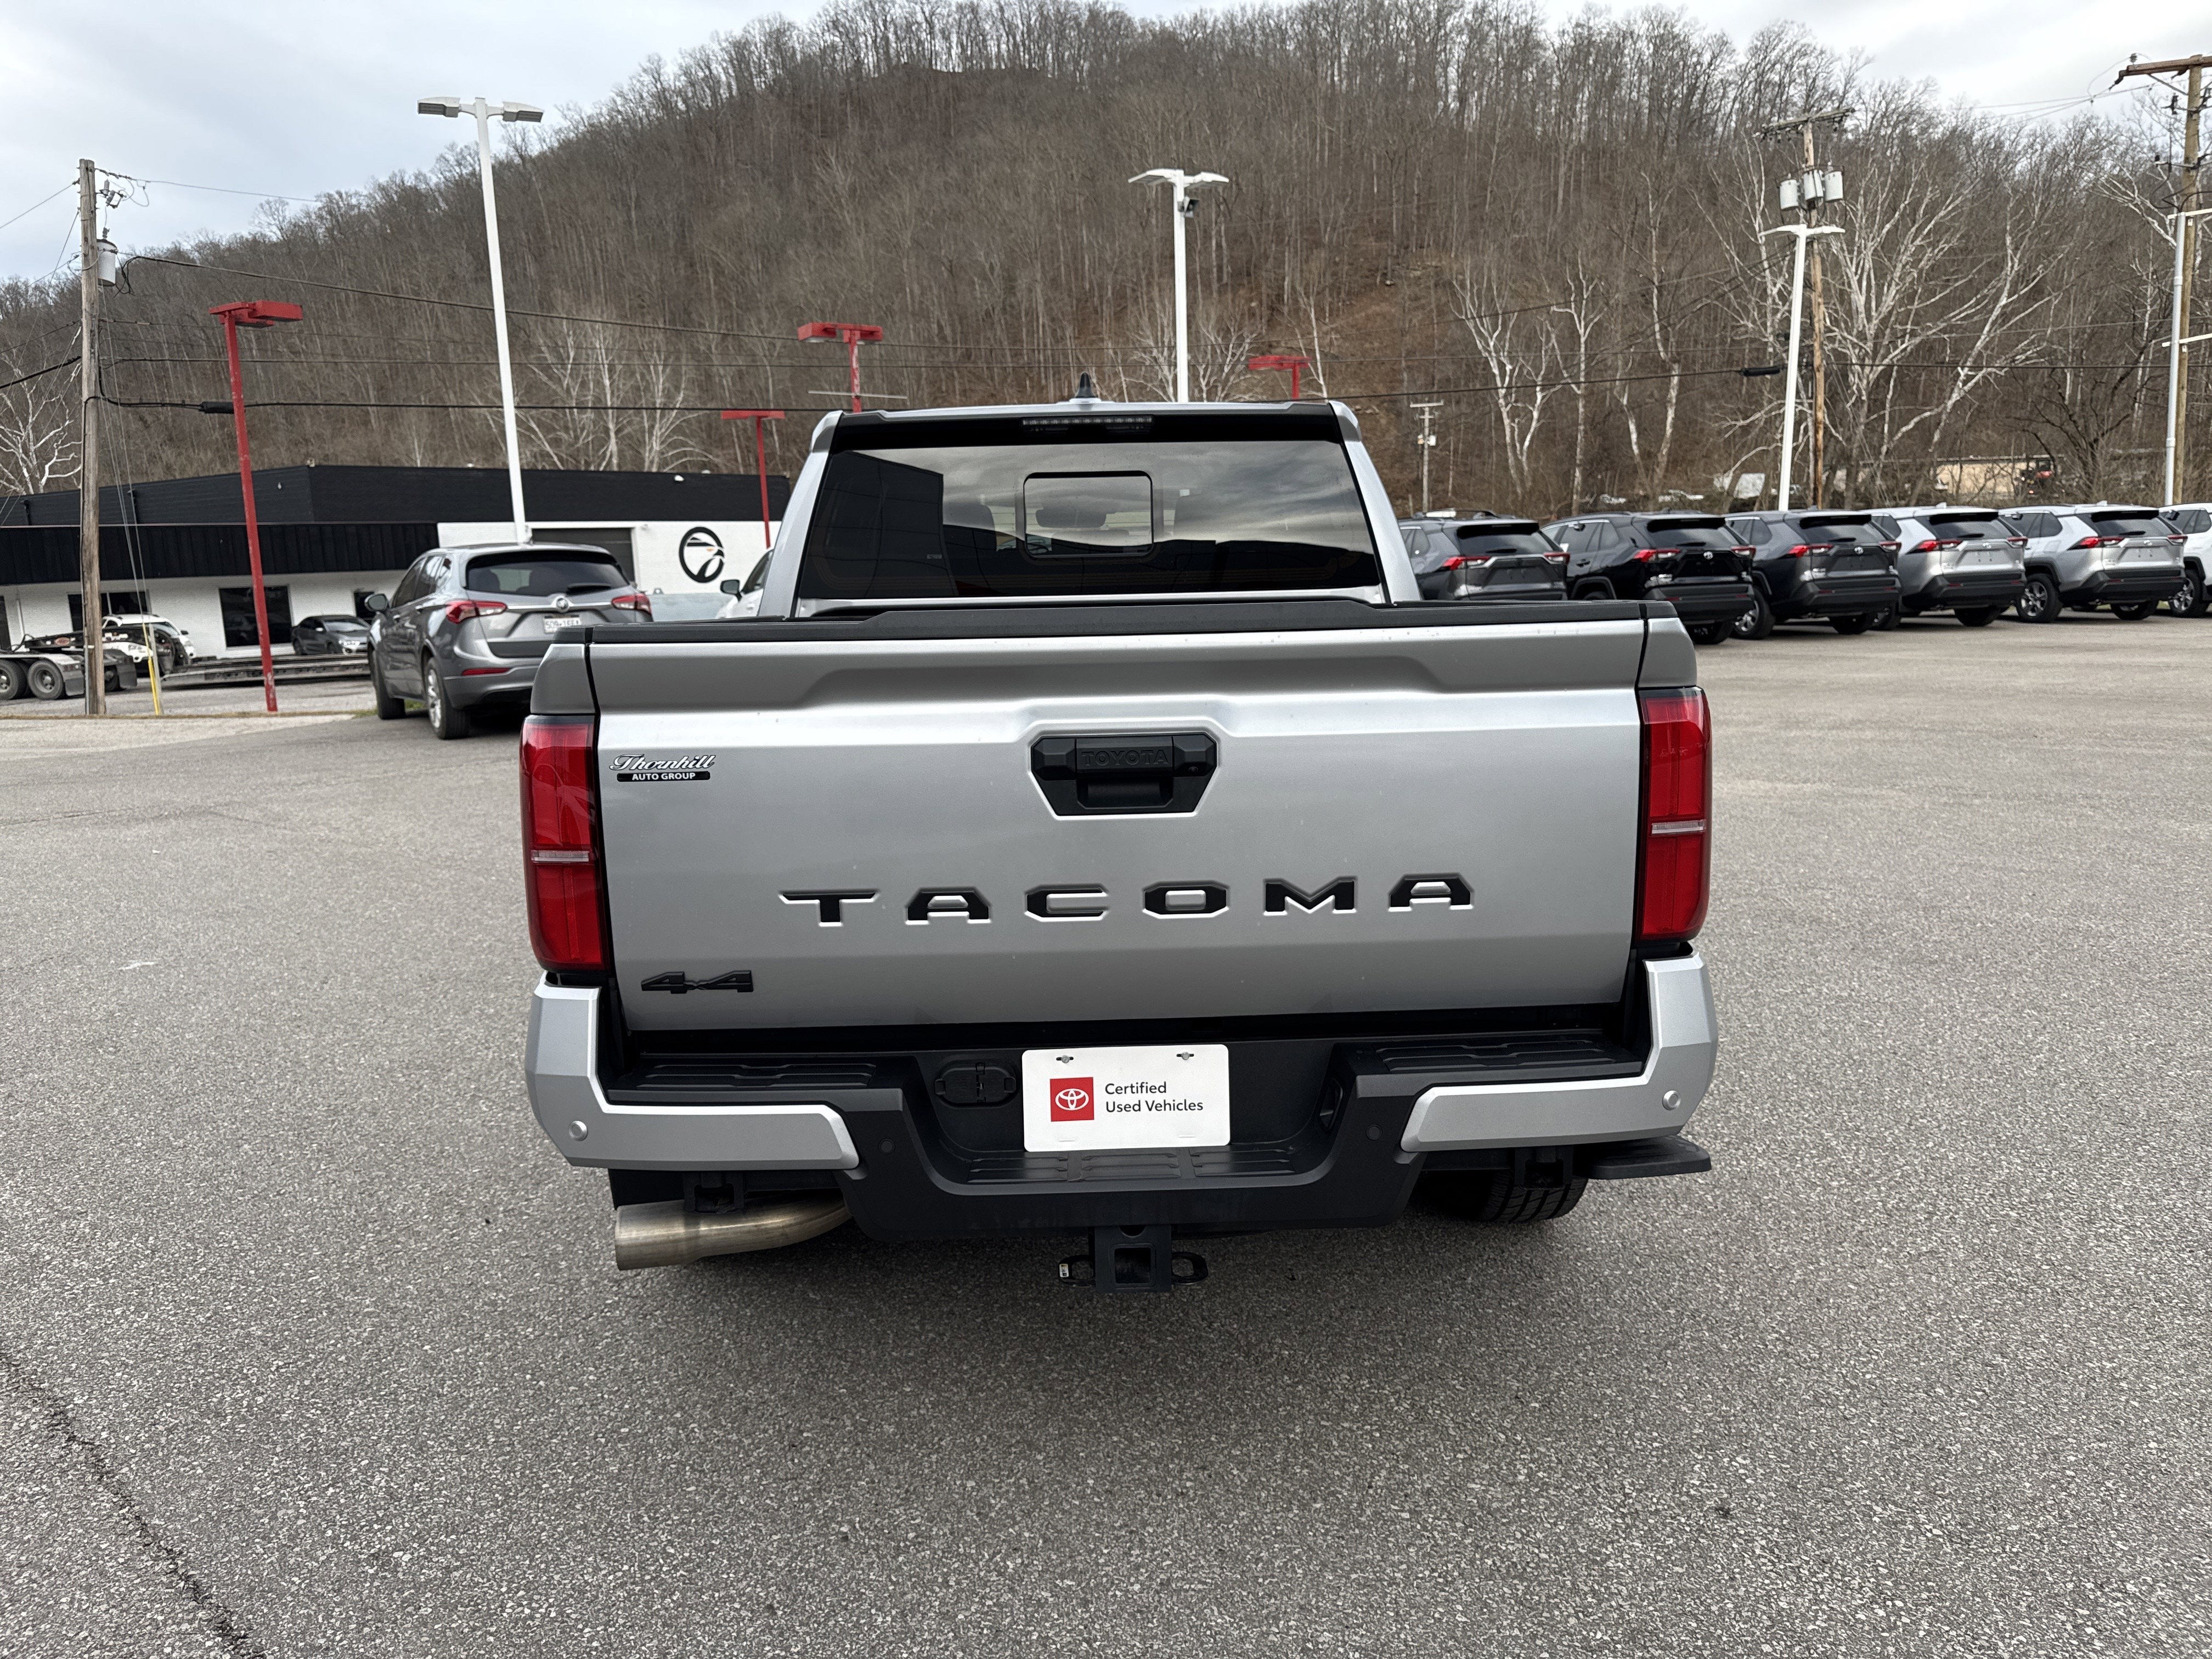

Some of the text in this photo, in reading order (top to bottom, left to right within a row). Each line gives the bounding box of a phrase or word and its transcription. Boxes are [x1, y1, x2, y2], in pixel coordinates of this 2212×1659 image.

[610, 753, 716, 770] Thornhill
[1082, 749, 1169, 766] TOYOTA
[779, 873, 1474, 927] TACOMA
[1105, 1081, 1167, 1094] Certified
[1106, 1099, 1204, 1113] Used Vehicles
